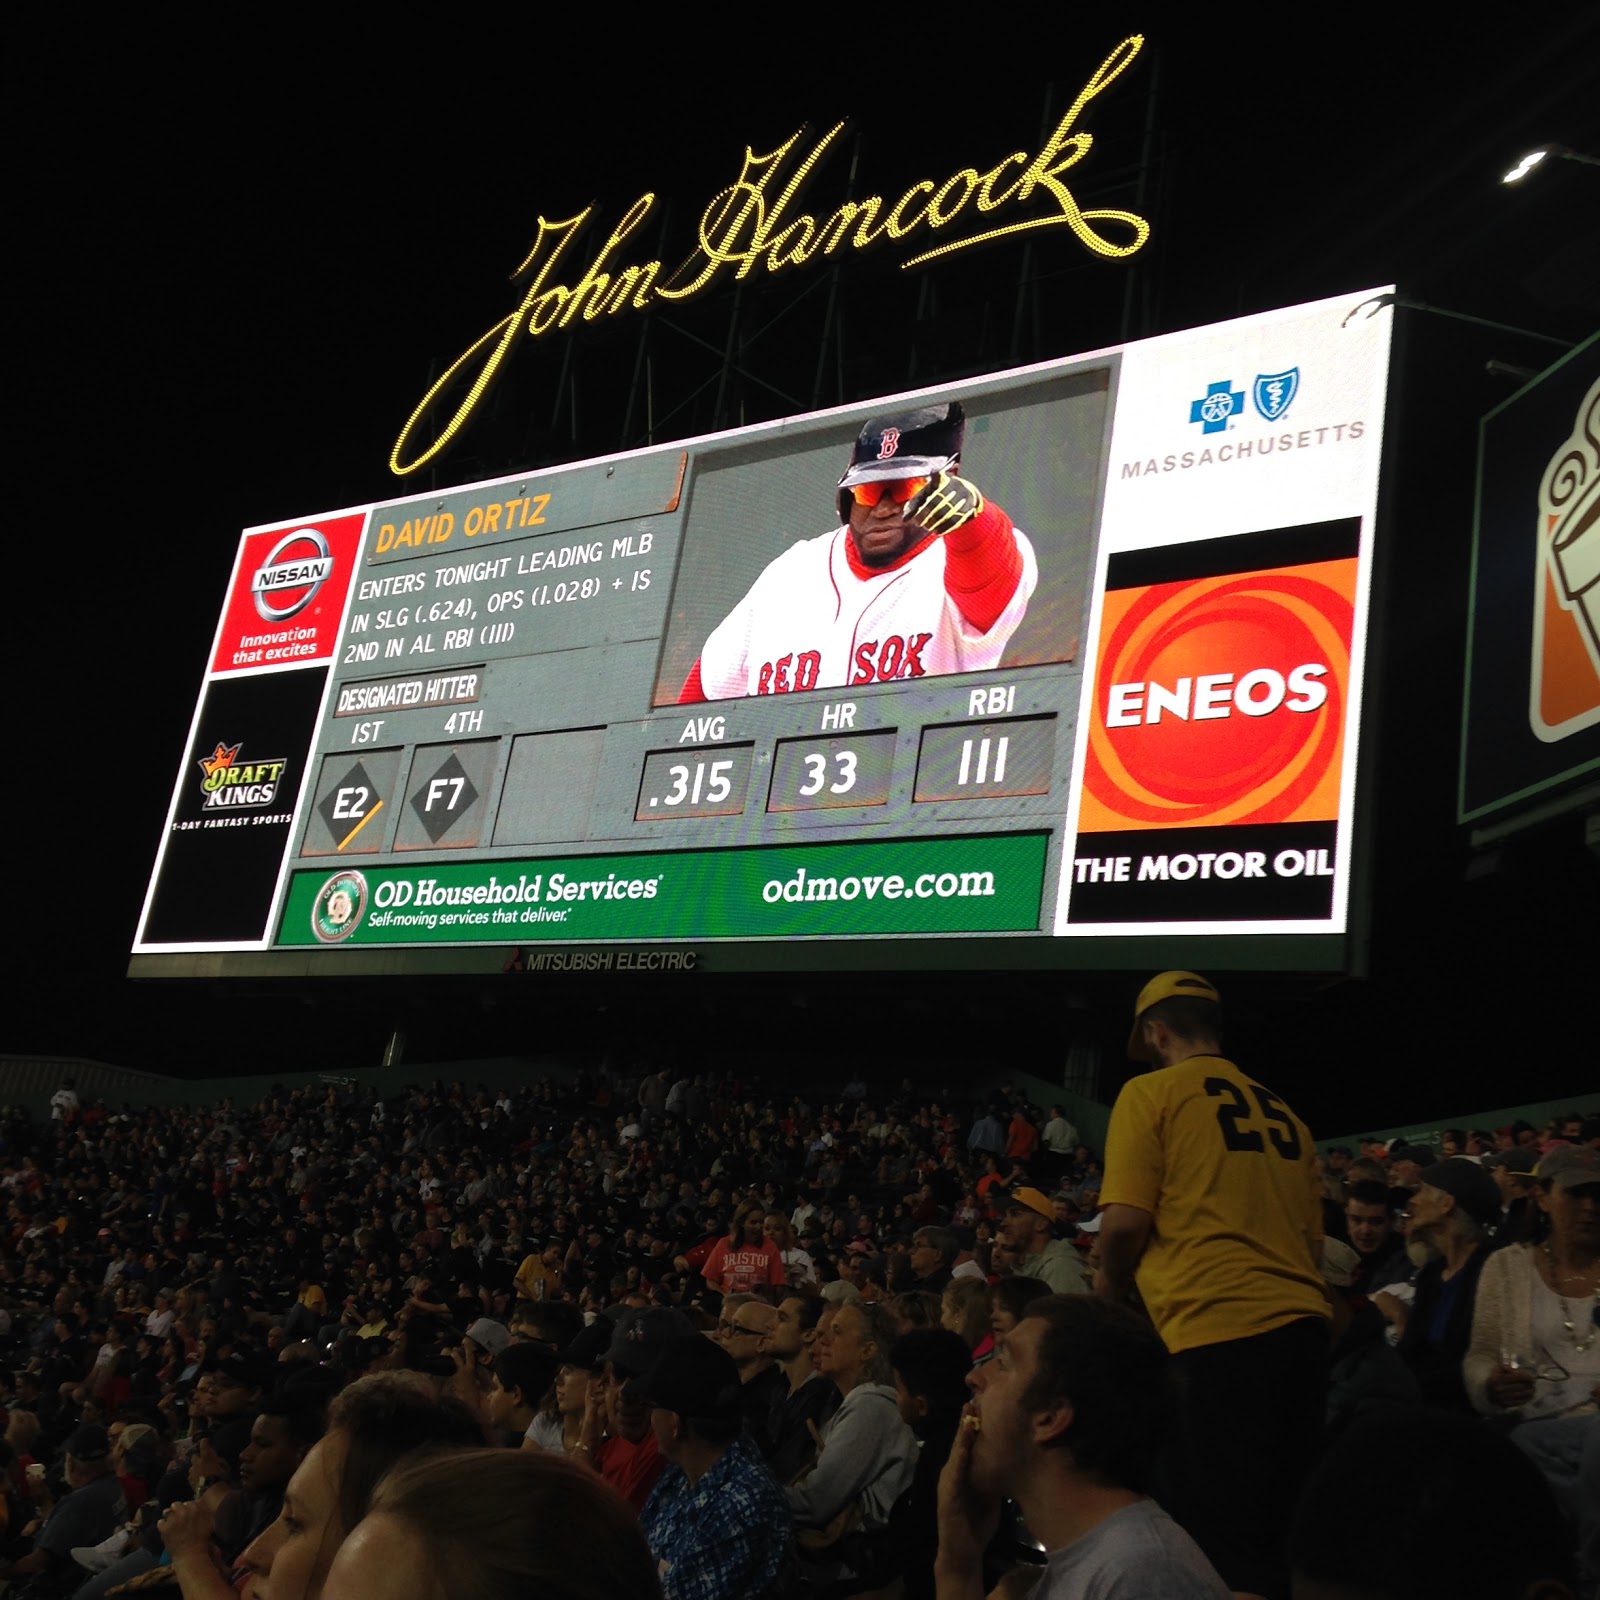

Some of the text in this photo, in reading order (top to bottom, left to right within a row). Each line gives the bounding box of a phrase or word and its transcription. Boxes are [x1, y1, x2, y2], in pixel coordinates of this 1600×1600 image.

[389, 34, 1151, 476] John Hancock
[877, 427, 901, 460] B
[1120, 420, 1366, 480] MASSACHUSETTS
[375, 493, 551, 553] DAVID ORTIZ
[258, 563, 325, 587] NISSAN
[359, 532, 653, 600] ENTERS TONIGHT LEADING MLB
[350, 613, 370, 633] IN
[375, 607, 409, 630] SLG
[415, 597, 477, 624] (.624),
[487, 589, 524, 613] OPS
[531, 577, 600, 606] (1.028)
[631, 569, 651, 592] IS
[232, 642, 317, 665] that excites
[239, 626, 317, 649] Innovation
[343, 641, 379, 664] 2ND
[384, 637, 404, 658] IN
[409, 633, 435, 655] AL
[443, 628, 474, 651] RBI
[757, 632, 933, 696] RED SOX
[337, 674, 478, 713] DESIGNATED HITTER
[1105, 663, 1328, 728] ENEOS
[351, 709, 484, 744] 1ST 4TH
[680, 686, 1015, 744] AVG HR RBI
[203, 762, 283, 792] DRAFT
[207, 783, 275, 807] KINGS
[649, 760, 733, 807] .315
[799, 750, 858, 796] 33
[332, 777, 465, 820] E2 F7
[171, 813, 292, 831] 1-DAY FANTASY SPORTS
[1074, 849, 1334, 883] THE MOTOR OIL
[374, 868, 996, 908] OD Household Services odmove.com
[368, 906, 568, 929] Self-moving services that deliver.
[527, 951, 697, 972] MITSUBISHI ELECTRIC
[1202, 1077, 1302, 1161] 25
